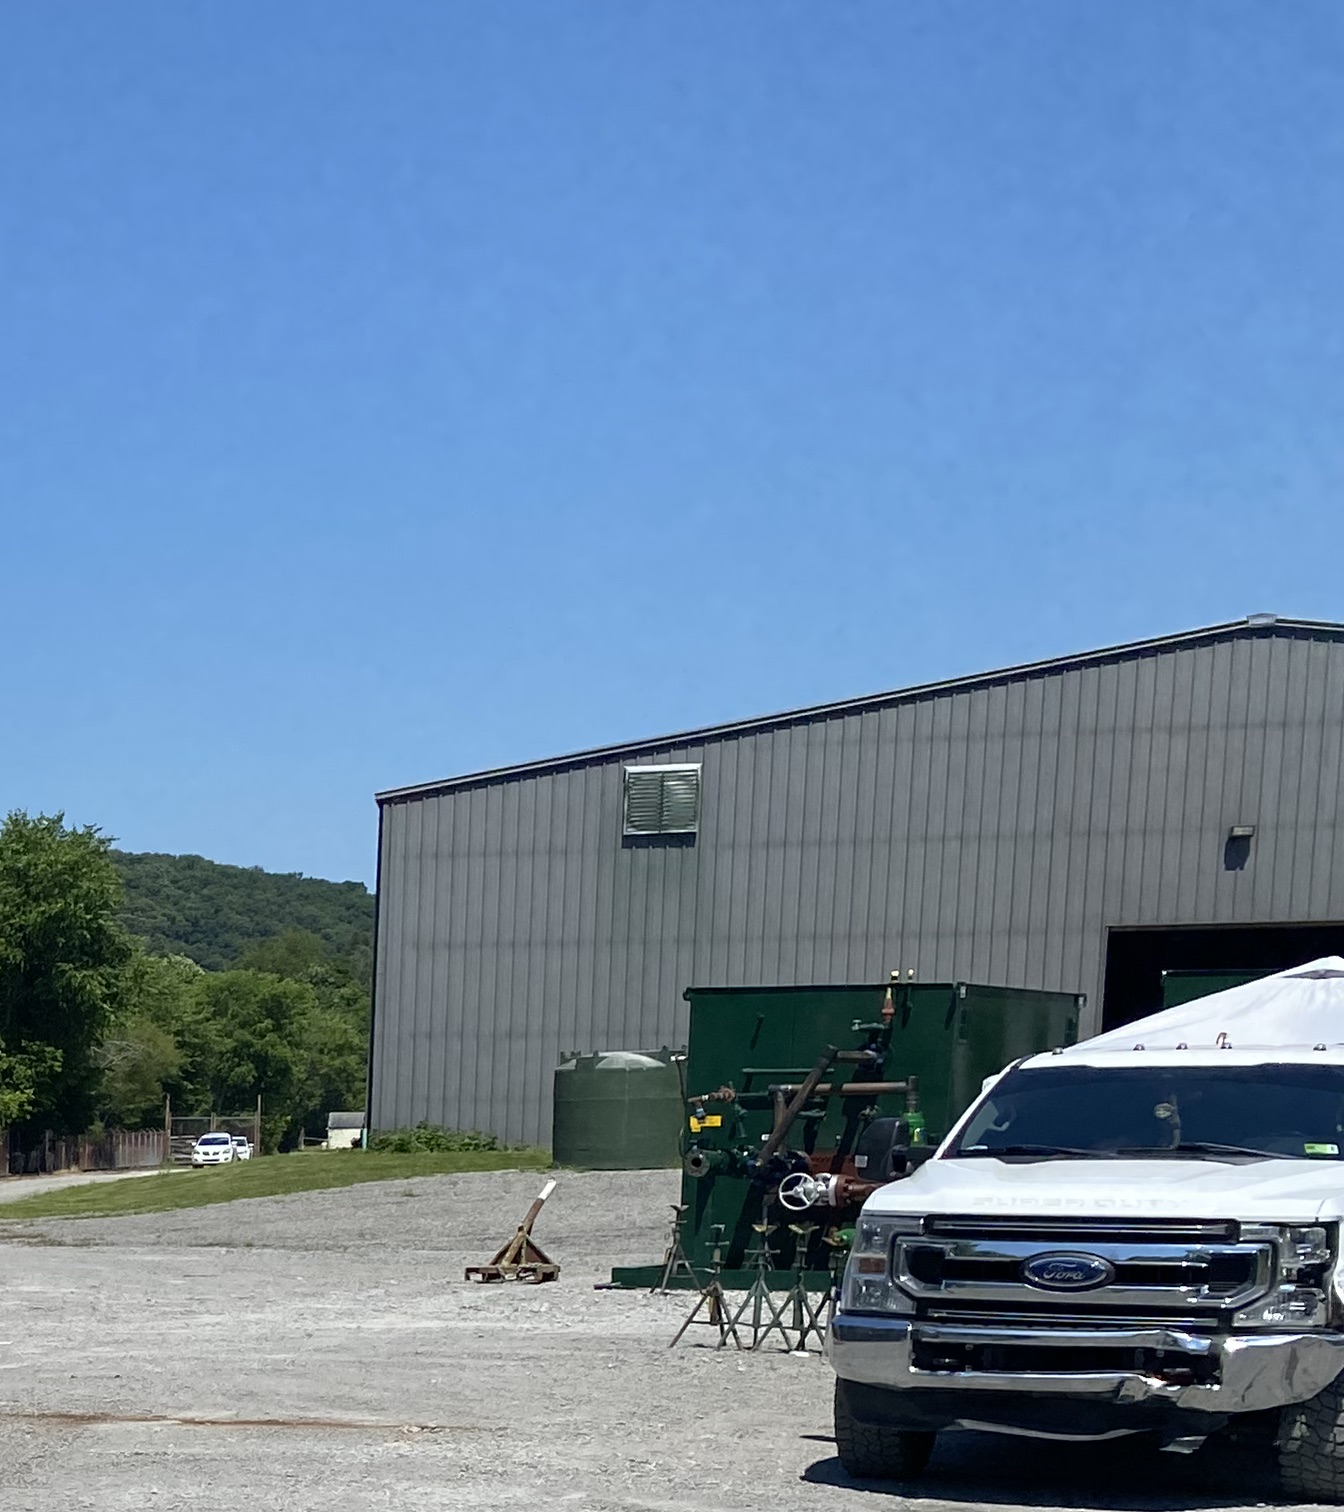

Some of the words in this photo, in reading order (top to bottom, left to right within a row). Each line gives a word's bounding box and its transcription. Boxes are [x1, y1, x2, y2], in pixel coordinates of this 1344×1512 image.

[972, 1196, 1085, 1208] SUPER
[1094, 1198, 1188, 1209] DUTY
[1043, 1262, 1086, 1280] Ford
